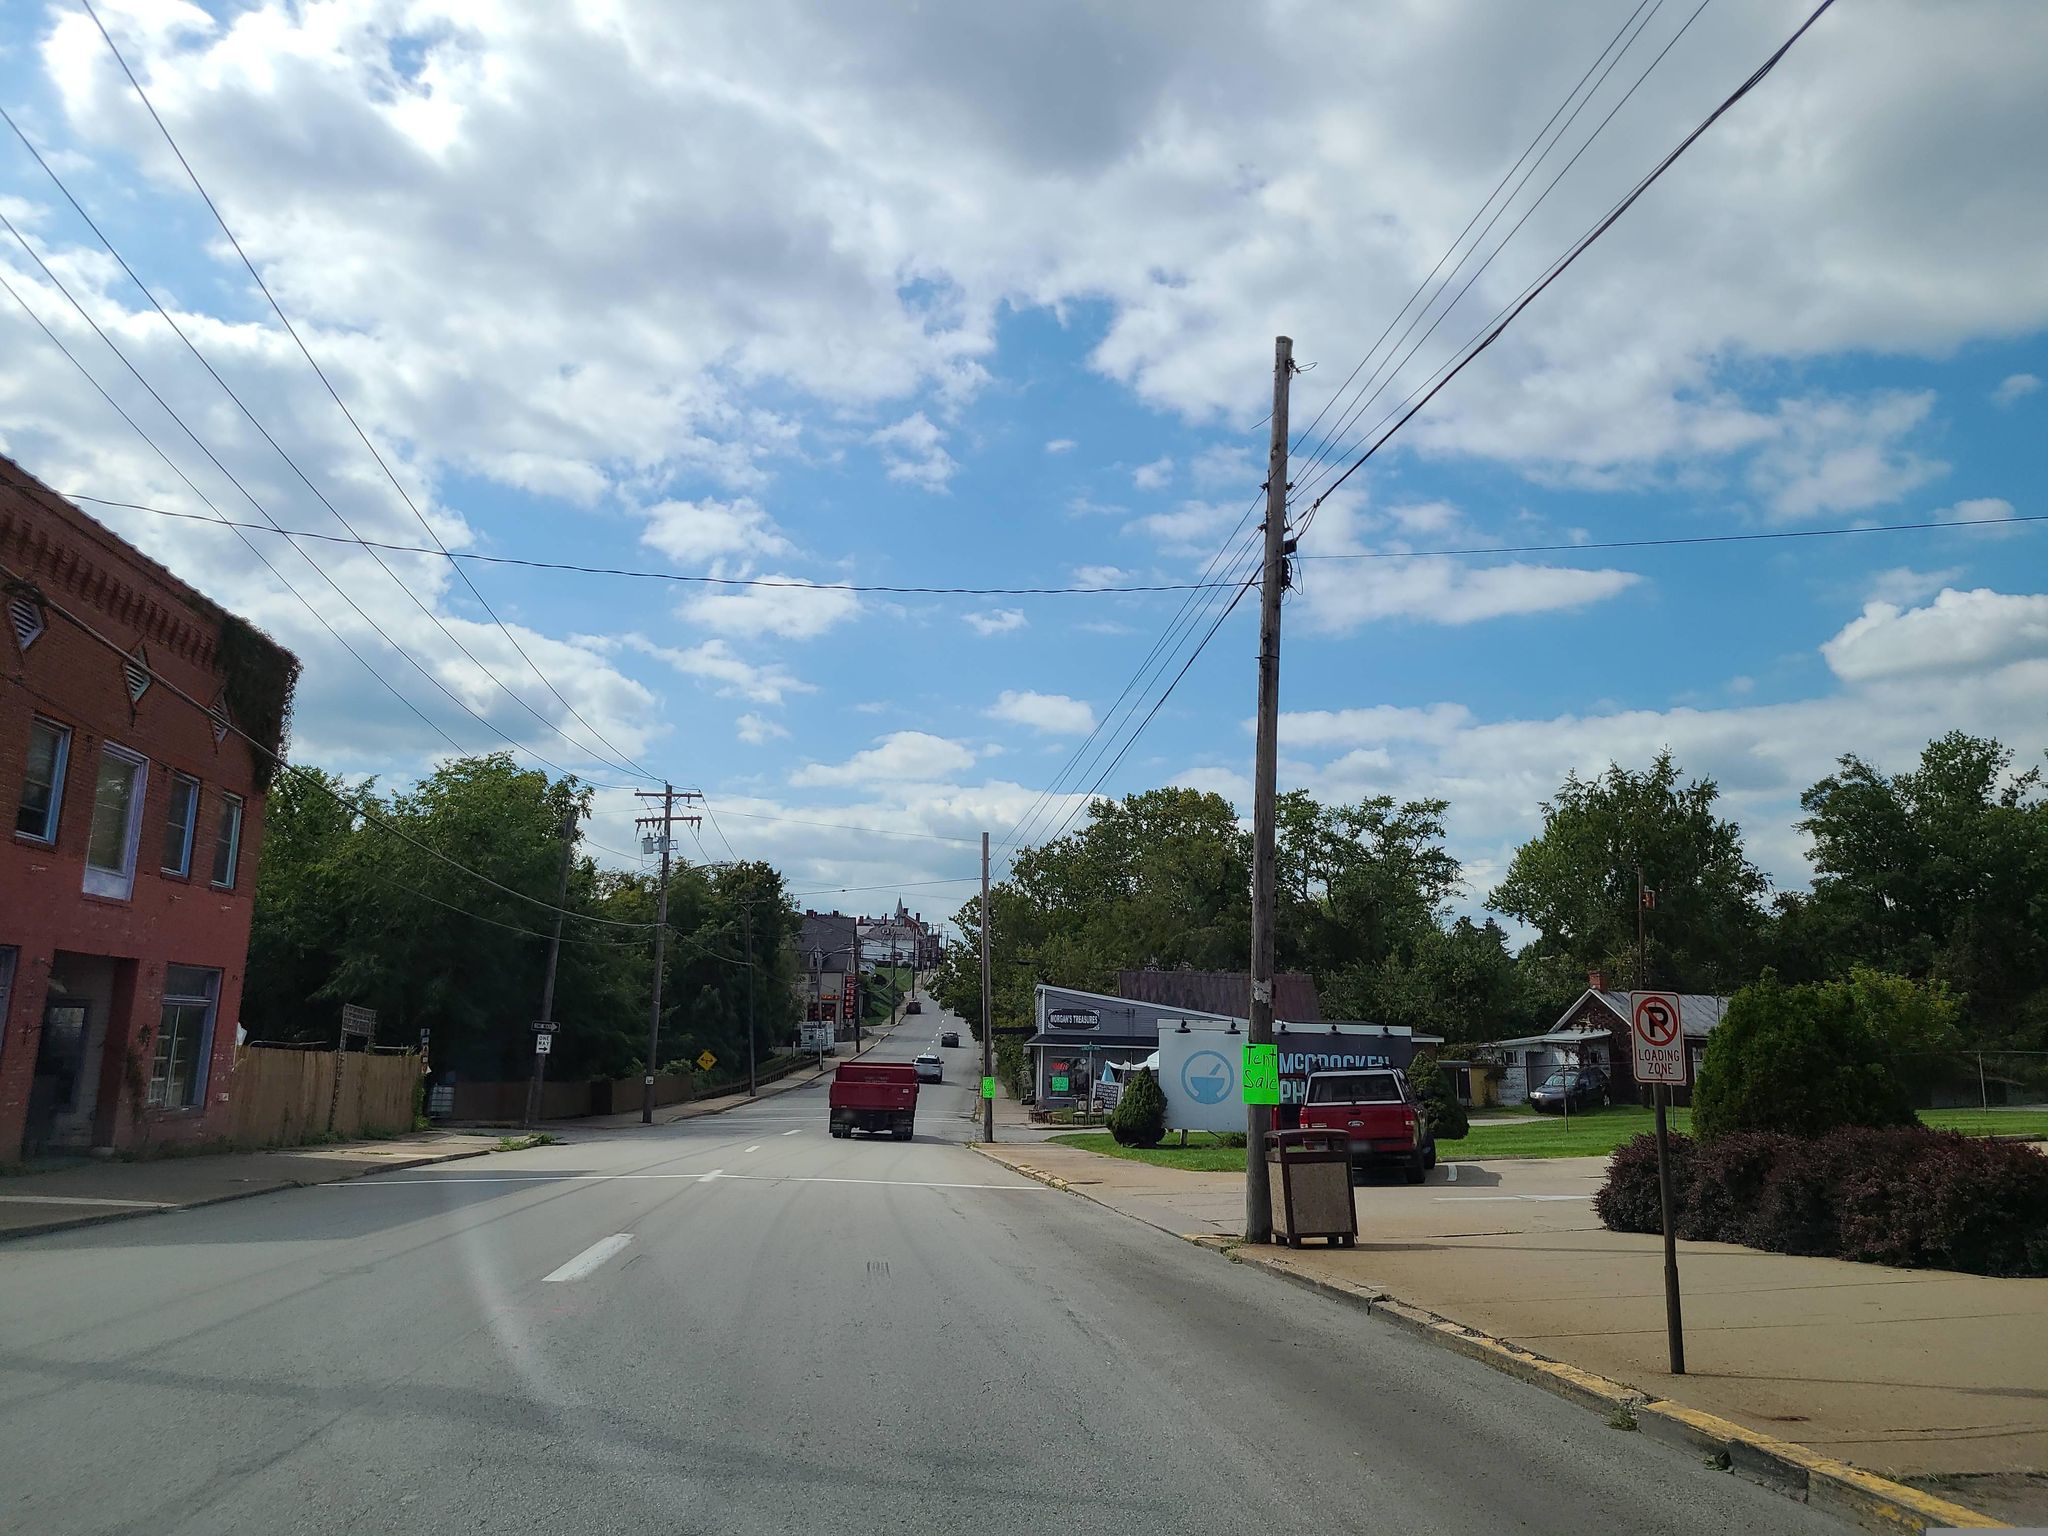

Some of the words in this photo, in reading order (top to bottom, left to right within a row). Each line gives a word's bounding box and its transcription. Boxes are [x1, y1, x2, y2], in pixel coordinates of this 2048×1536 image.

[1050, 1014, 1072, 1023] MORGAN'S
[1073, 1015, 1098, 1024] TREASURES
[1245, 1045, 1277, 1066] Tent
[1638, 1049, 1680, 1062] LOADING
[1647, 1062, 1674, 1075] ZONE
[1244, 1069, 1278, 1090] Sale
